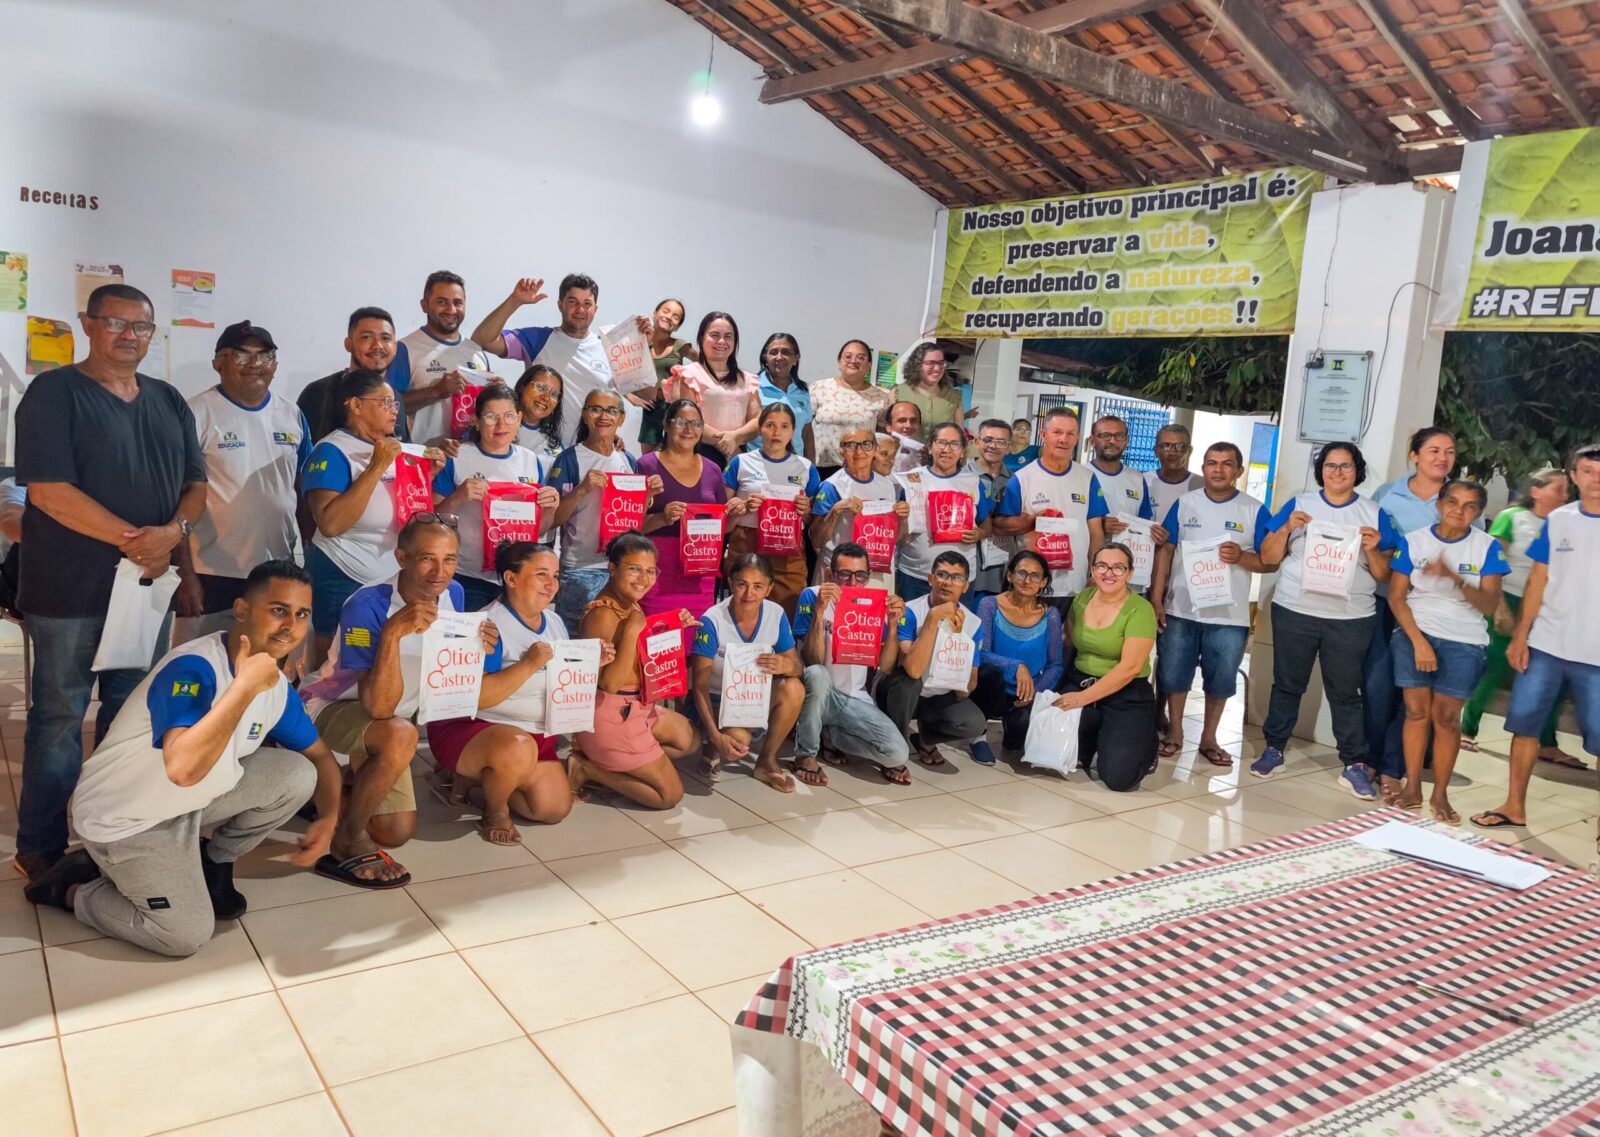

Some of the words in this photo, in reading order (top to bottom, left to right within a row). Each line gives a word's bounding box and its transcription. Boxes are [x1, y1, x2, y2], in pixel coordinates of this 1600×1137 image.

[20, 186, 99, 211] Receitas
[963, 211, 1024, 231] Nosso
[1031, 199, 1123, 228] objetivo
[1130, 177, 1257, 218] principal
[1266, 173, 1296, 199] é:
[1007, 235, 1117, 265] preservar
[1124, 233, 1140, 251] a
[1149, 225, 1215, 250] vida,
[1484, 220, 1600, 257] Joan
[971, 270, 1098, 296] defendendo
[1105, 273, 1120, 290] a
[1128, 263, 1260, 290] natureza,
[965, 306, 1103, 332] recuperando
[1111, 299, 1258, 332] gerações!!
[605, 512, 638, 528] Castro
[760, 518, 794, 534] Castro
[488, 526, 531, 542] Castro
[683, 542, 718, 556] Castro
[1037, 536, 1068, 550] Castro
[837, 625, 875, 641] Castro
[644, 660, 677, 677] Castro
[428, 669, 475, 688] Castro
[551, 687, 592, 704] Castro
[726, 684, 763, 701] Castro
